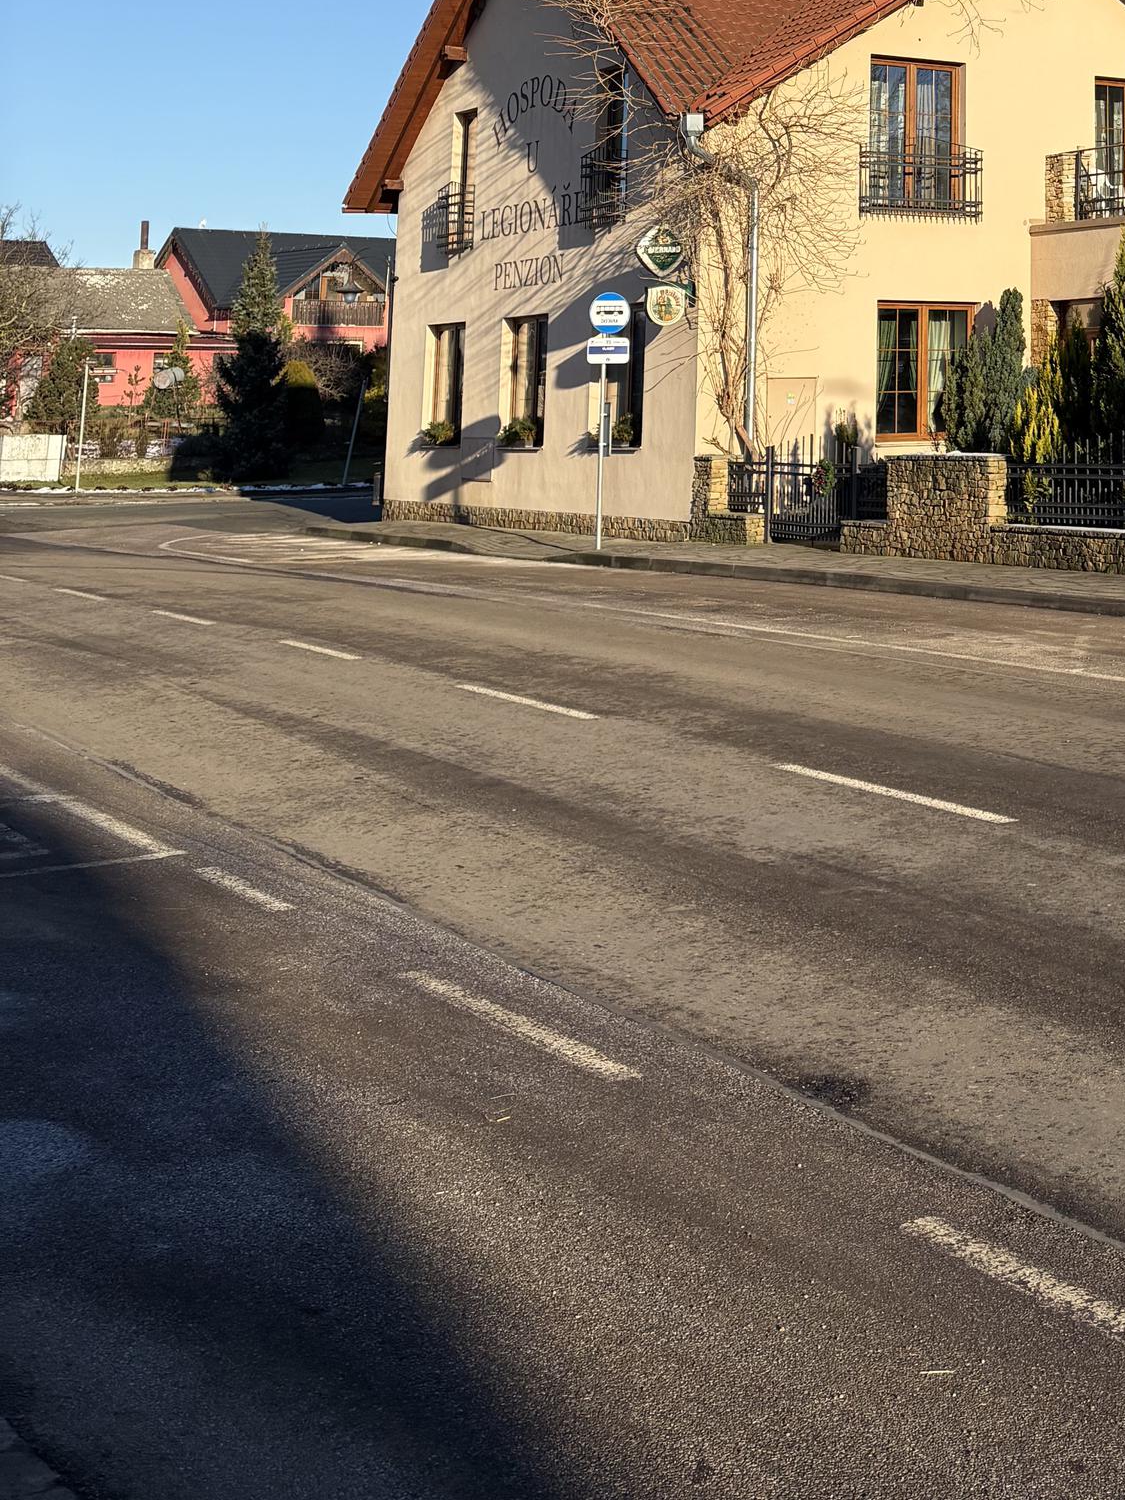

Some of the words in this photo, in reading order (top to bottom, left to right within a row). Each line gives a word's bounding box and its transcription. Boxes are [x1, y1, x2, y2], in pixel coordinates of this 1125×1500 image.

[492, 74, 577, 152] HOSPODA
[526, 140, 540, 173] U
[480, 182, 587, 241] LEGIONÁŘE
[494, 253, 564, 291] PENZION
